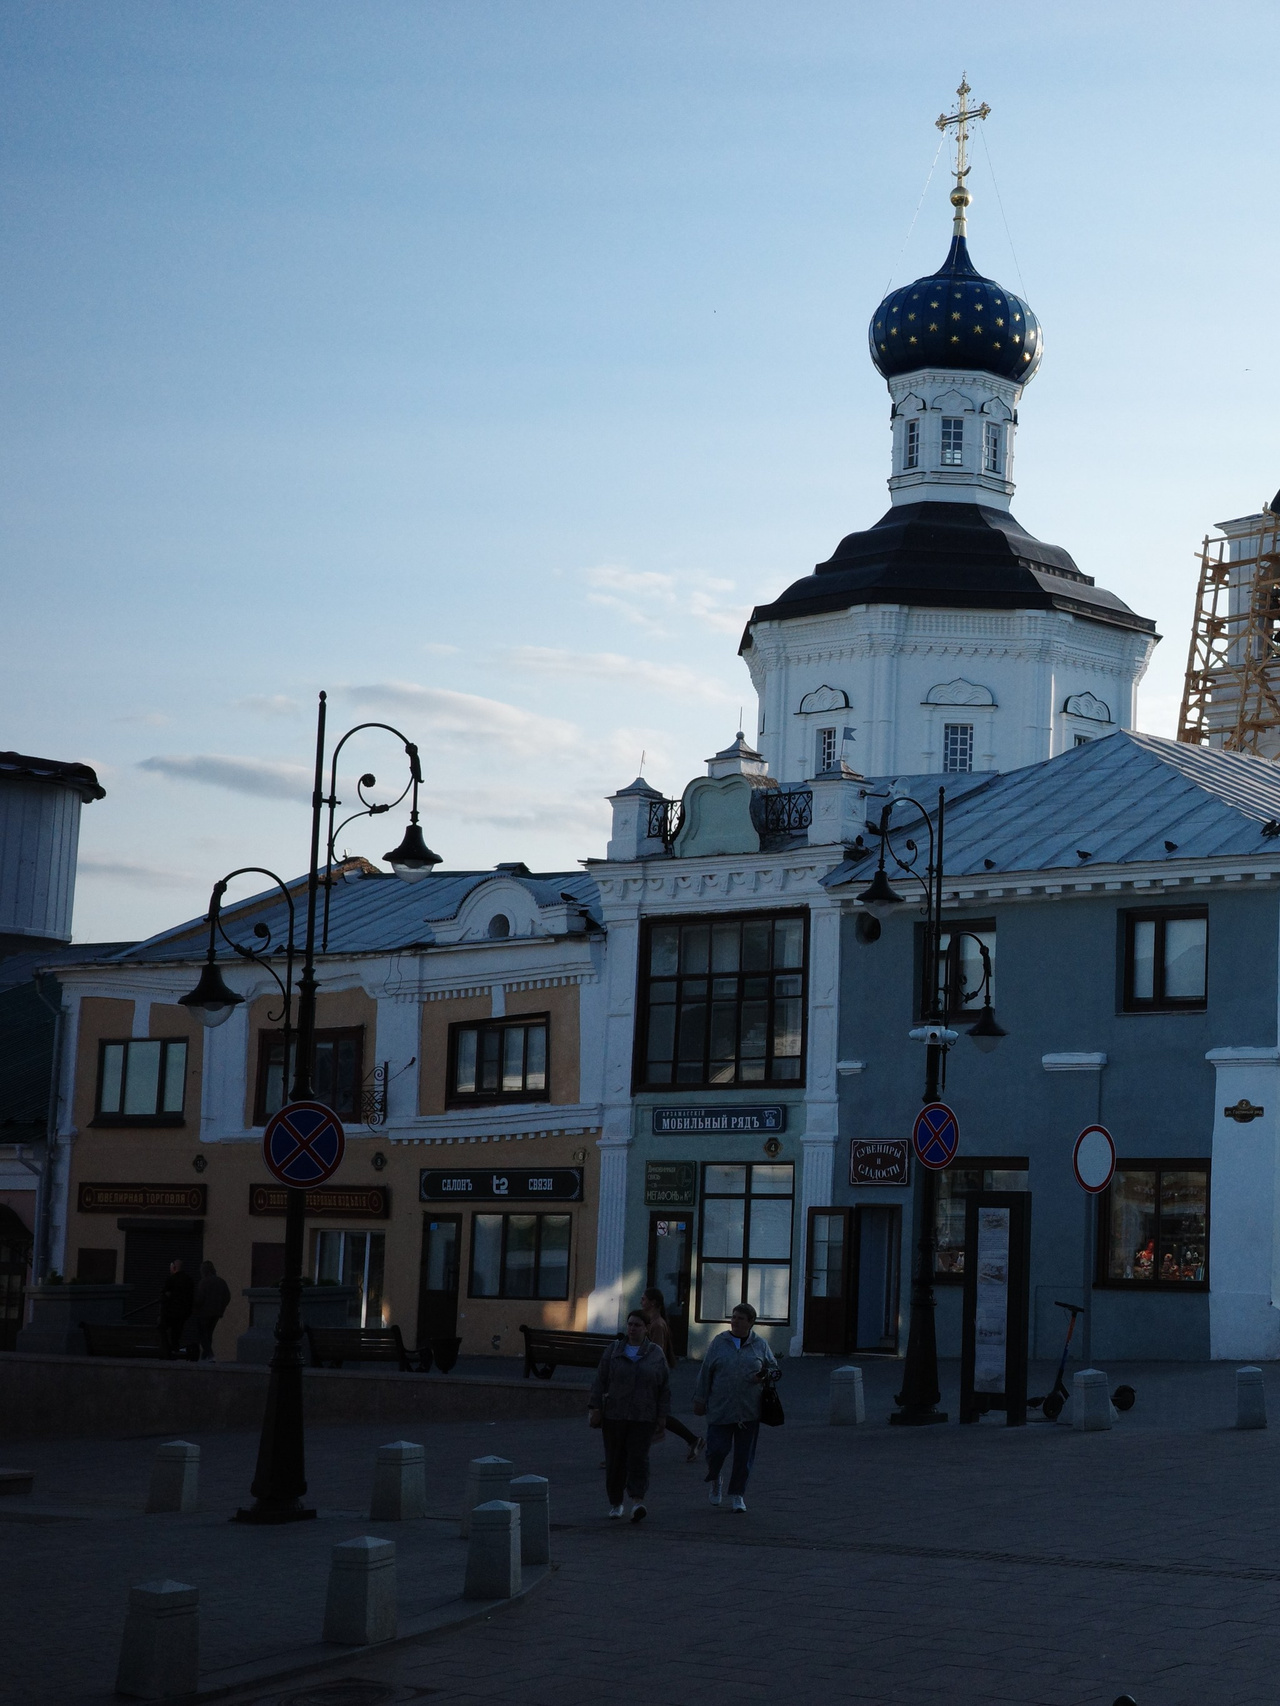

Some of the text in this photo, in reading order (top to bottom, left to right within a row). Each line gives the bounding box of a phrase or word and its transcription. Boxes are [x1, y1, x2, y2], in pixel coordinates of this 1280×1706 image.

[662, 1114, 760, 1130] МОБИЛЬНЫЙ РЯДЪ
[770, 1143, 775, 1152] 4
[856, 1144, 902, 1159] СУВЕНИРЫ
[858, 1163, 900, 1180] СЛАДОСТИ
[441, 1179, 473, 1191] САЛОНЪ
[528, 1178, 554, 1191] СВЯЗИ
[97, 1192, 186, 1204] ЮВЕЛИРНАЯ ТОРГОВЛЯ
[646, 1190, 680, 1201] МЕГАФОНЪ
